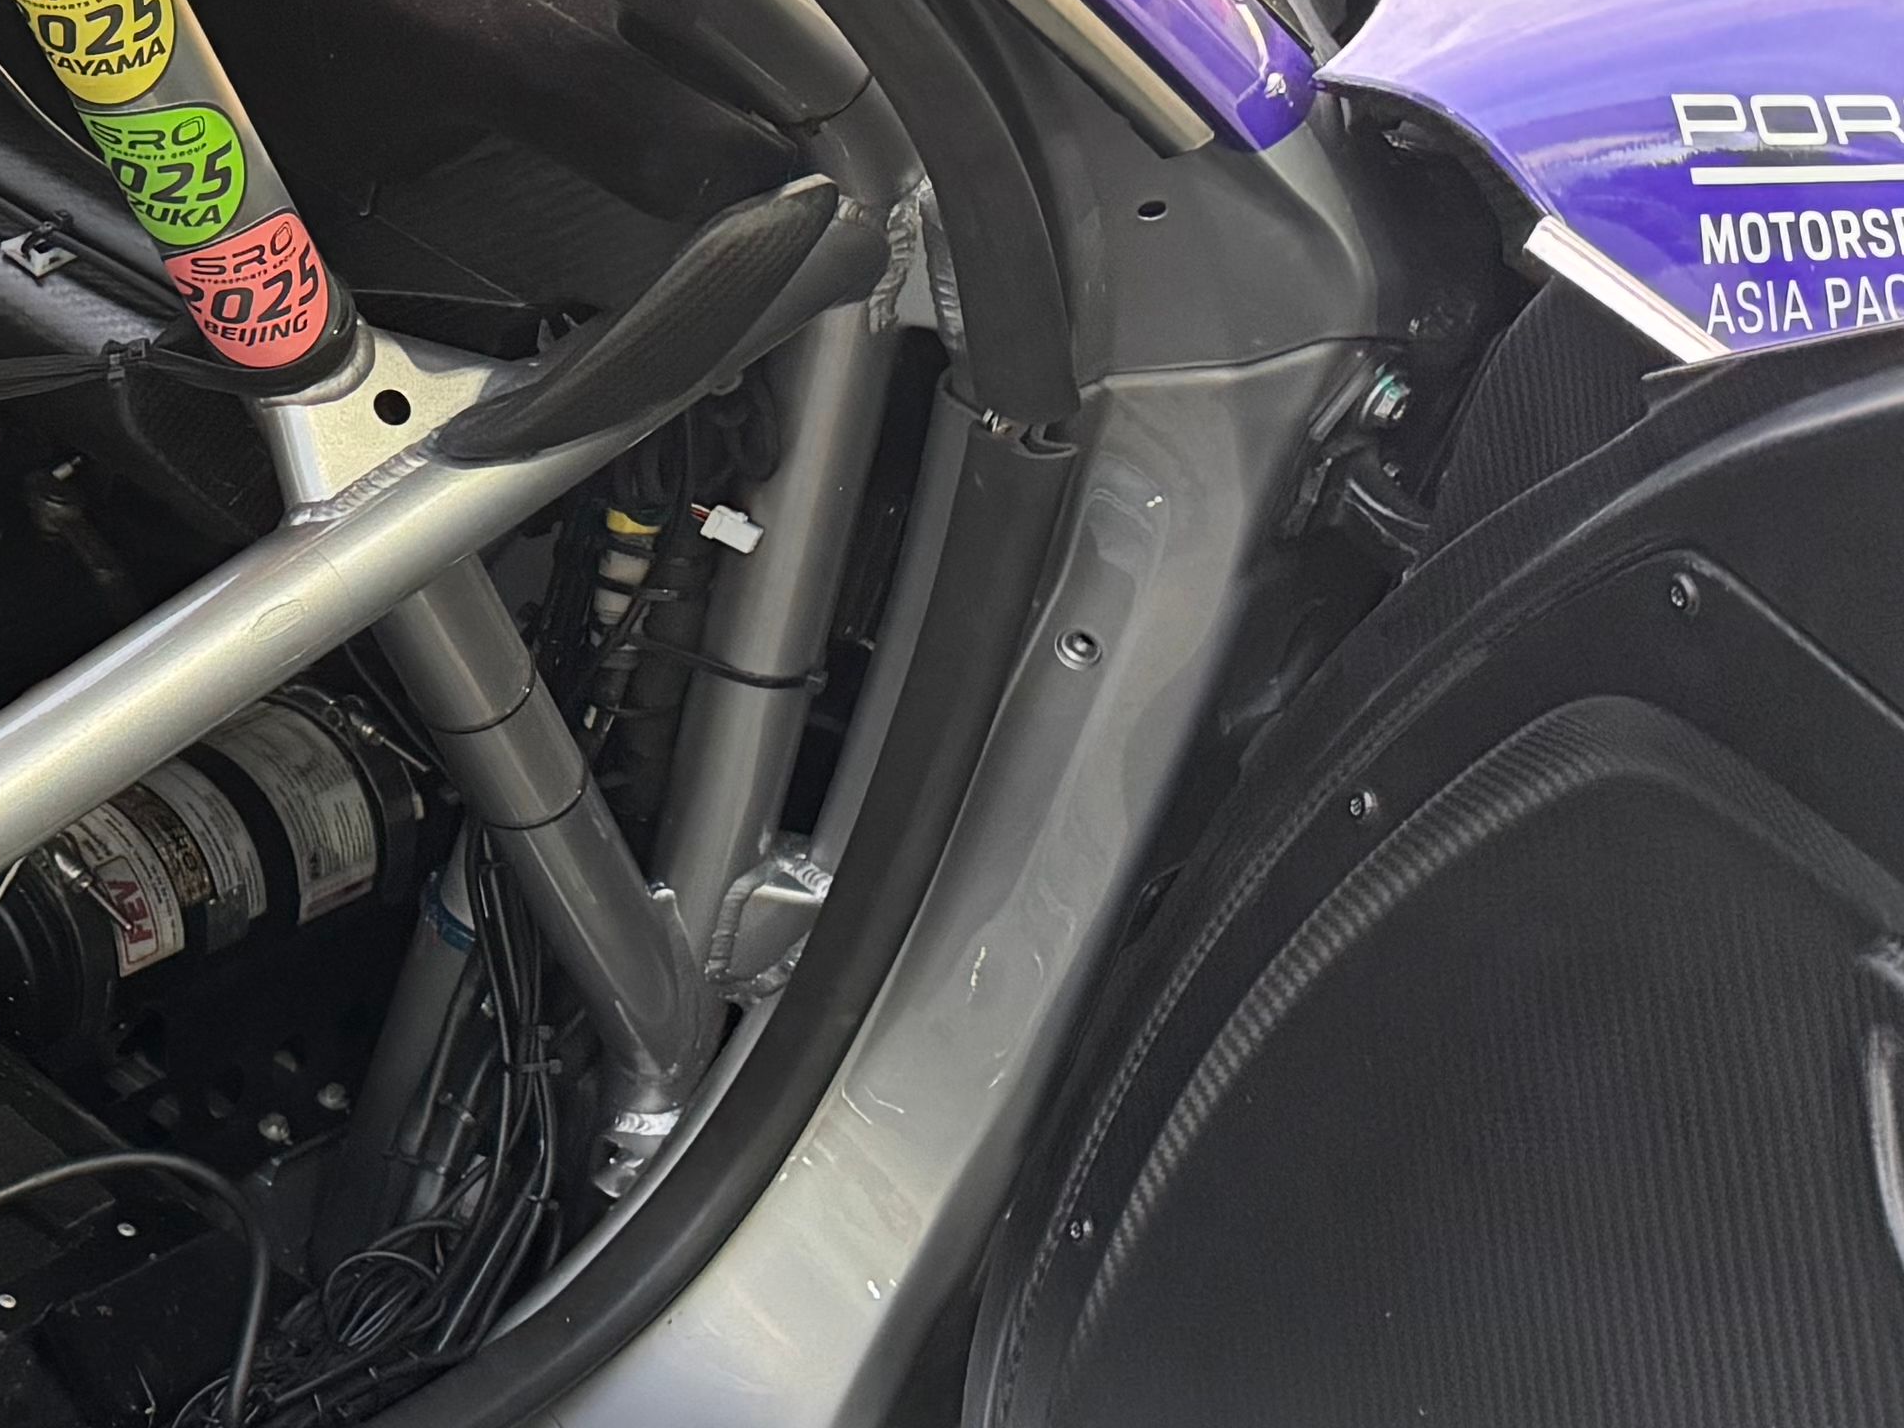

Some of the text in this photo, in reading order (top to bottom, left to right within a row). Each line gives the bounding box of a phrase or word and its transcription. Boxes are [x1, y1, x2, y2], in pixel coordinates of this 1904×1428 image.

[90, 115, 206, 151] SRO
[1671, 94, 1904, 146] POR
[110, 140, 233, 205] 025
[190, 221, 293, 276] SRO
[175, 241, 319, 325] 2025
[1706, 279, 1814, 335] ASIA
[204, 310, 308, 347] BEIJING
